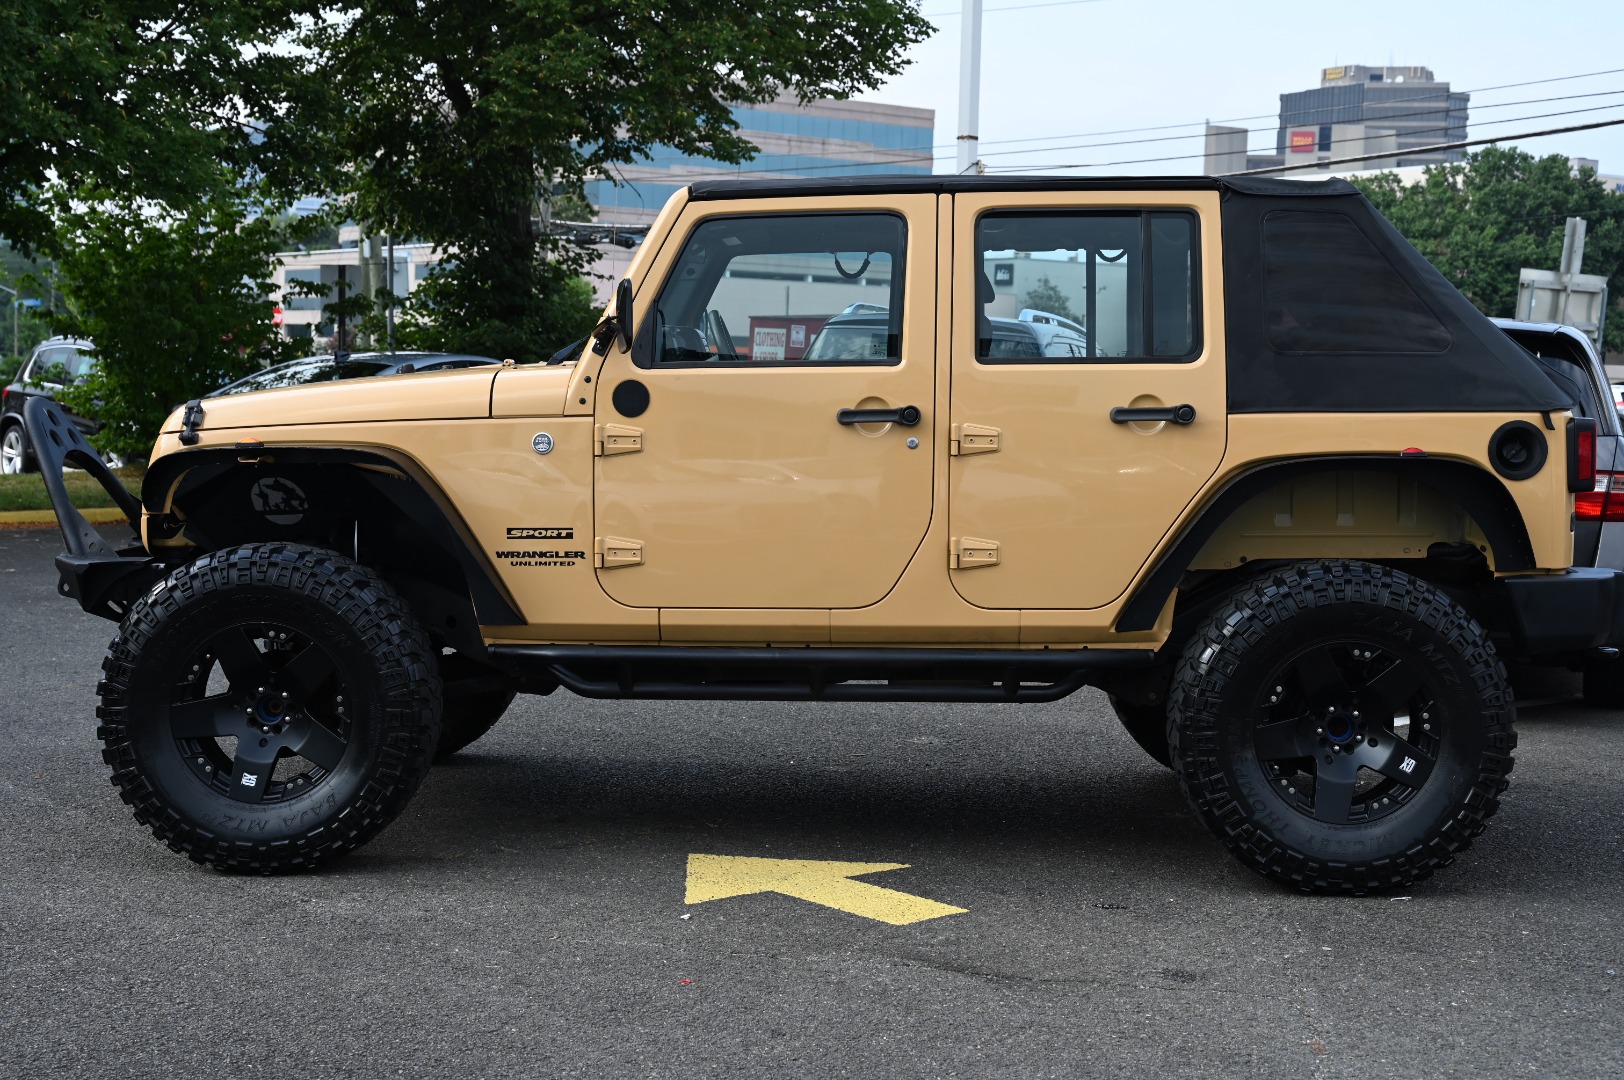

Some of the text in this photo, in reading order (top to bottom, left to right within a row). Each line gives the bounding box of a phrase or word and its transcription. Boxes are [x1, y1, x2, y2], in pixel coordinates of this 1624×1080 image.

[755, 331, 786, 348] CLOTHING
[507, 528, 573, 538] SPORT
[495, 551, 587, 560] WRANGLER
[281, 791, 338, 827] BAJA
[214, 813, 270, 833] MTZ
[1297, 832, 1397, 855] MICKEY
